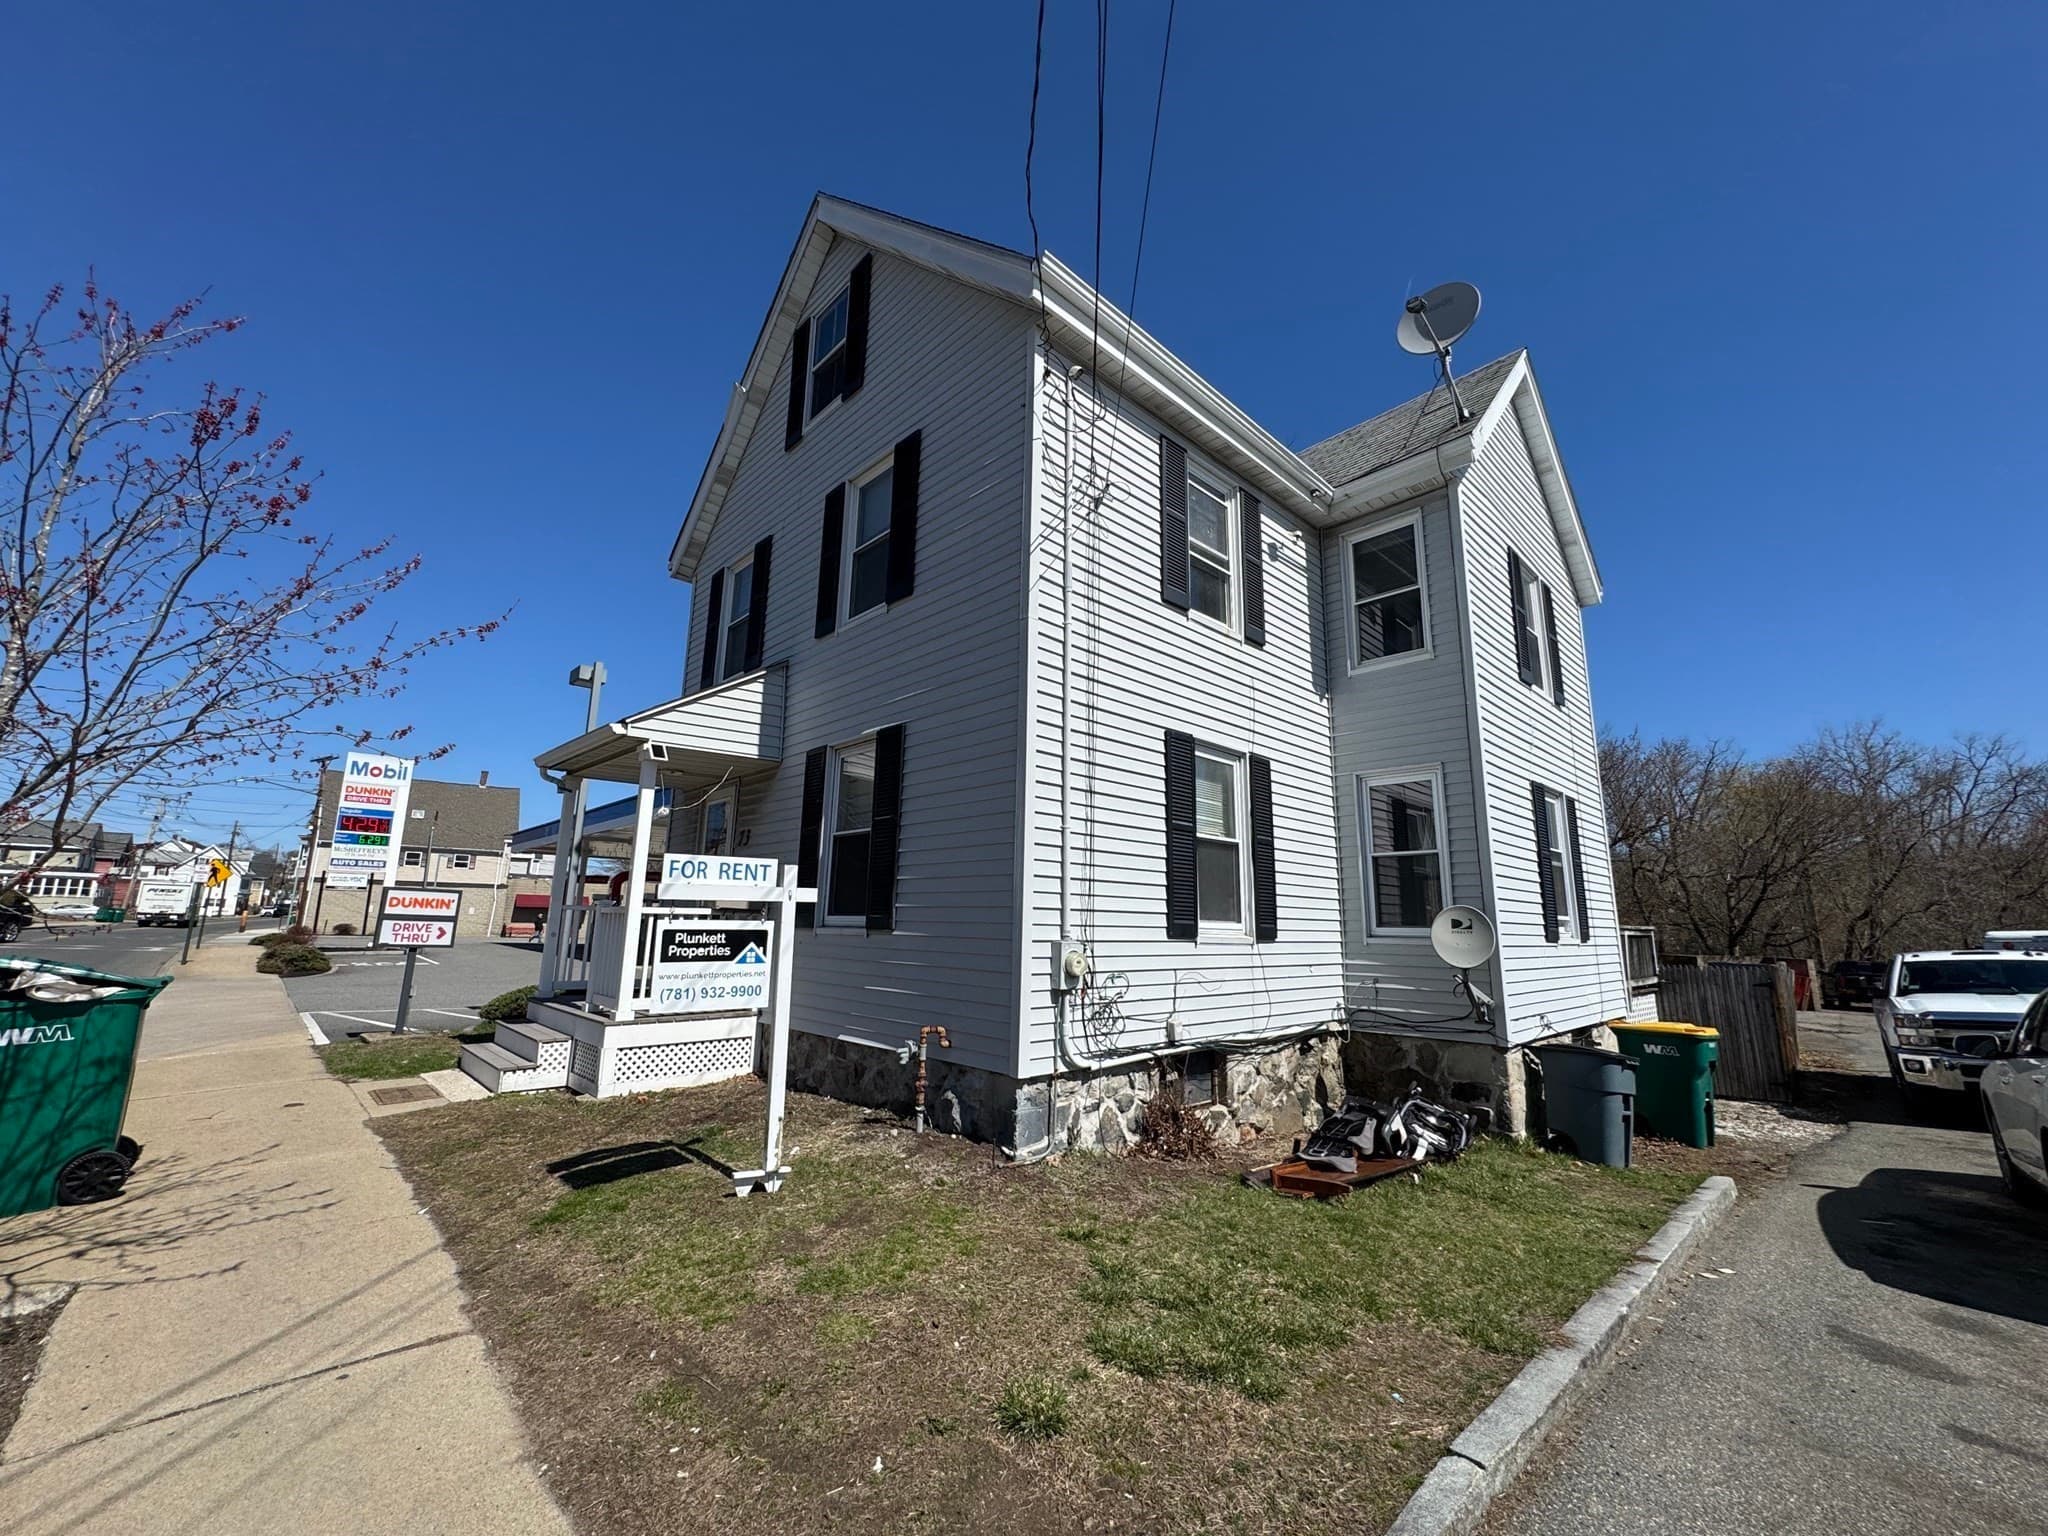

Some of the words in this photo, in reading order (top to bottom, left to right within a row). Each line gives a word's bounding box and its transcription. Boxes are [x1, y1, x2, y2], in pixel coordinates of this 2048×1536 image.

[350, 761, 408, 780] Mobil
[345, 785, 395, 797] DUNKIN'
[346, 795, 368, 803] DRIVE
[669, 859, 708, 880] FOR
[718, 862, 772, 881] RENT
[388, 896, 455, 909] DUNKIN'
[391, 922, 433, 933] DRIVE
[392, 933, 430, 943] THRU
[675, 932, 727, 944] Plunkett
[668, 945, 731, 959] Properties
[658, 970, 766, 981] www.plunkettproperties.net
[660, 988, 696, 1004] (781)
[700, 984, 762, 999] 932-9900
[1643, 1043, 1680, 1057] WM
